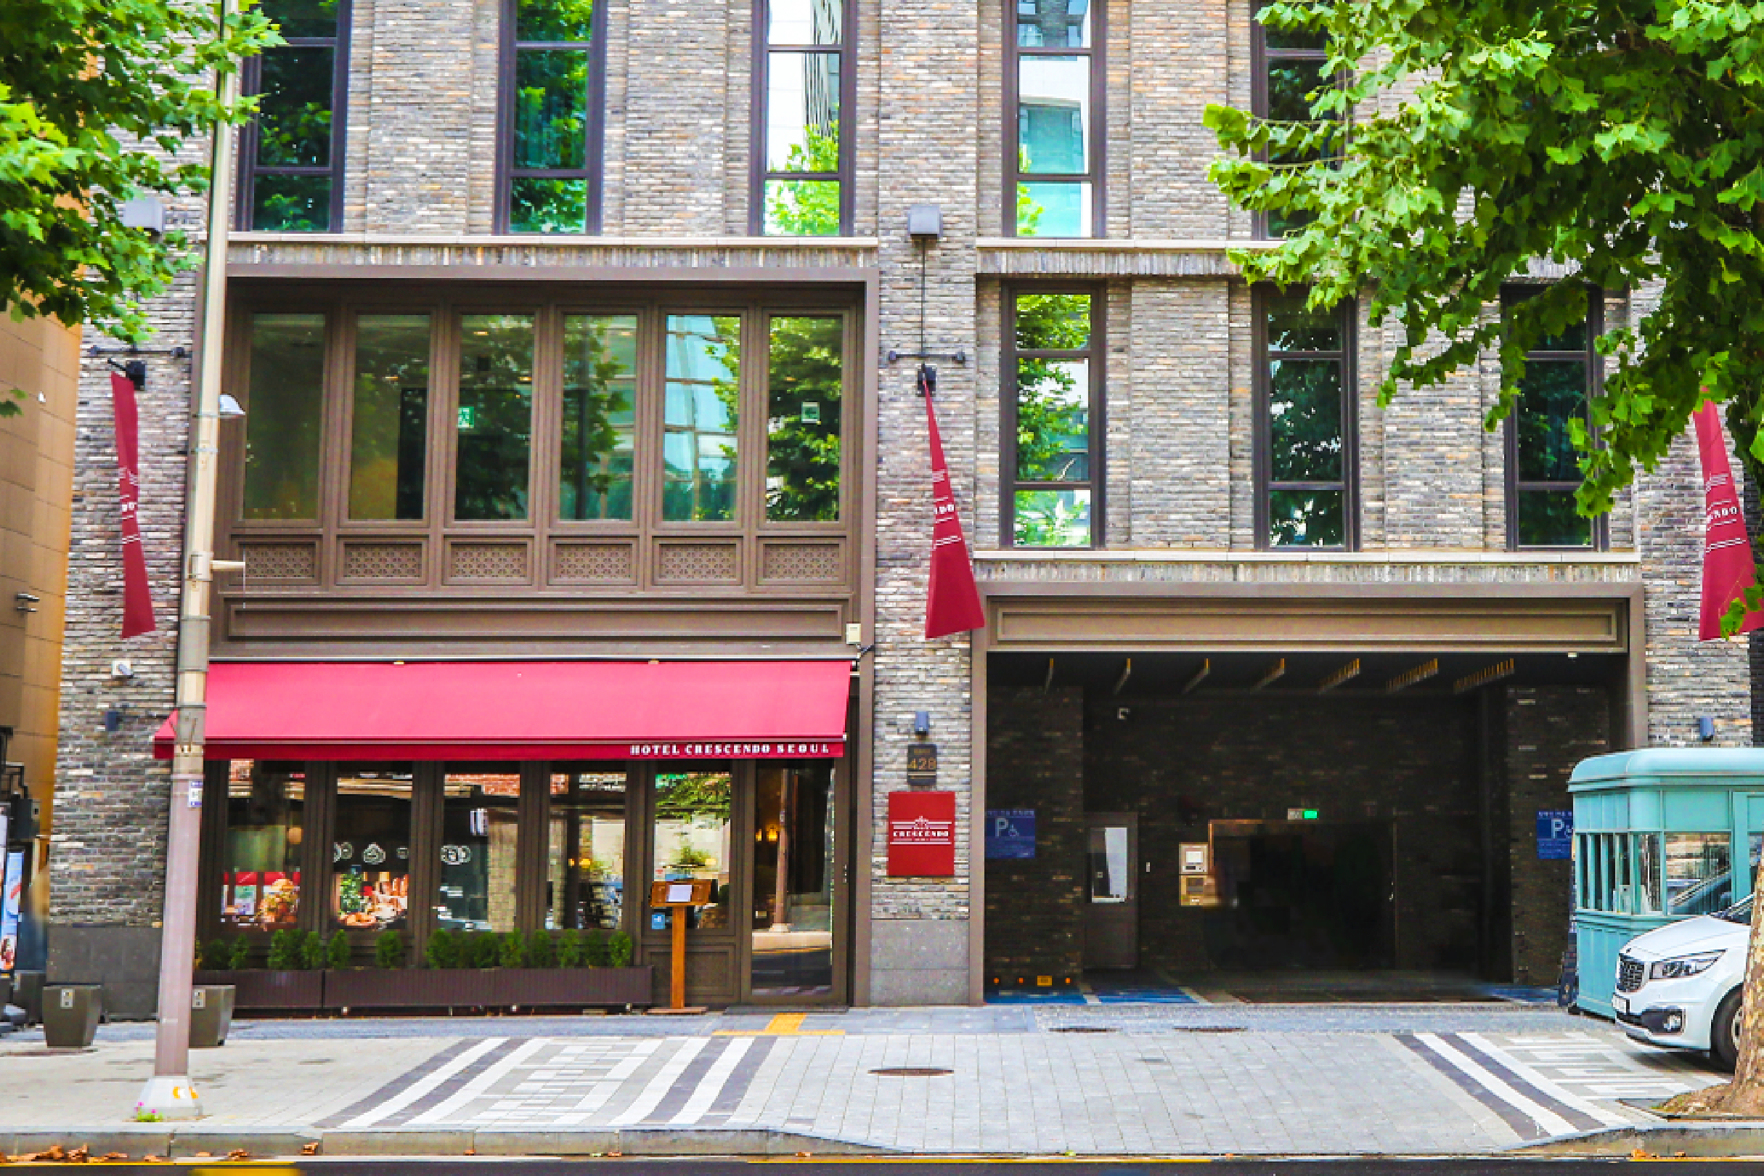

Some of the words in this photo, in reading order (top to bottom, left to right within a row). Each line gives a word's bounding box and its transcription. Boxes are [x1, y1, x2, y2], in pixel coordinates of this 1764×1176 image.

[630, 744, 680, 756] HOTEL
[684, 743, 770, 755] CRESCENDO
[776, 743, 829, 754] SEOUL
[907, 757, 937, 770] 428
[995, 817, 1008, 838] P
[1551, 818, 1564, 838] P
